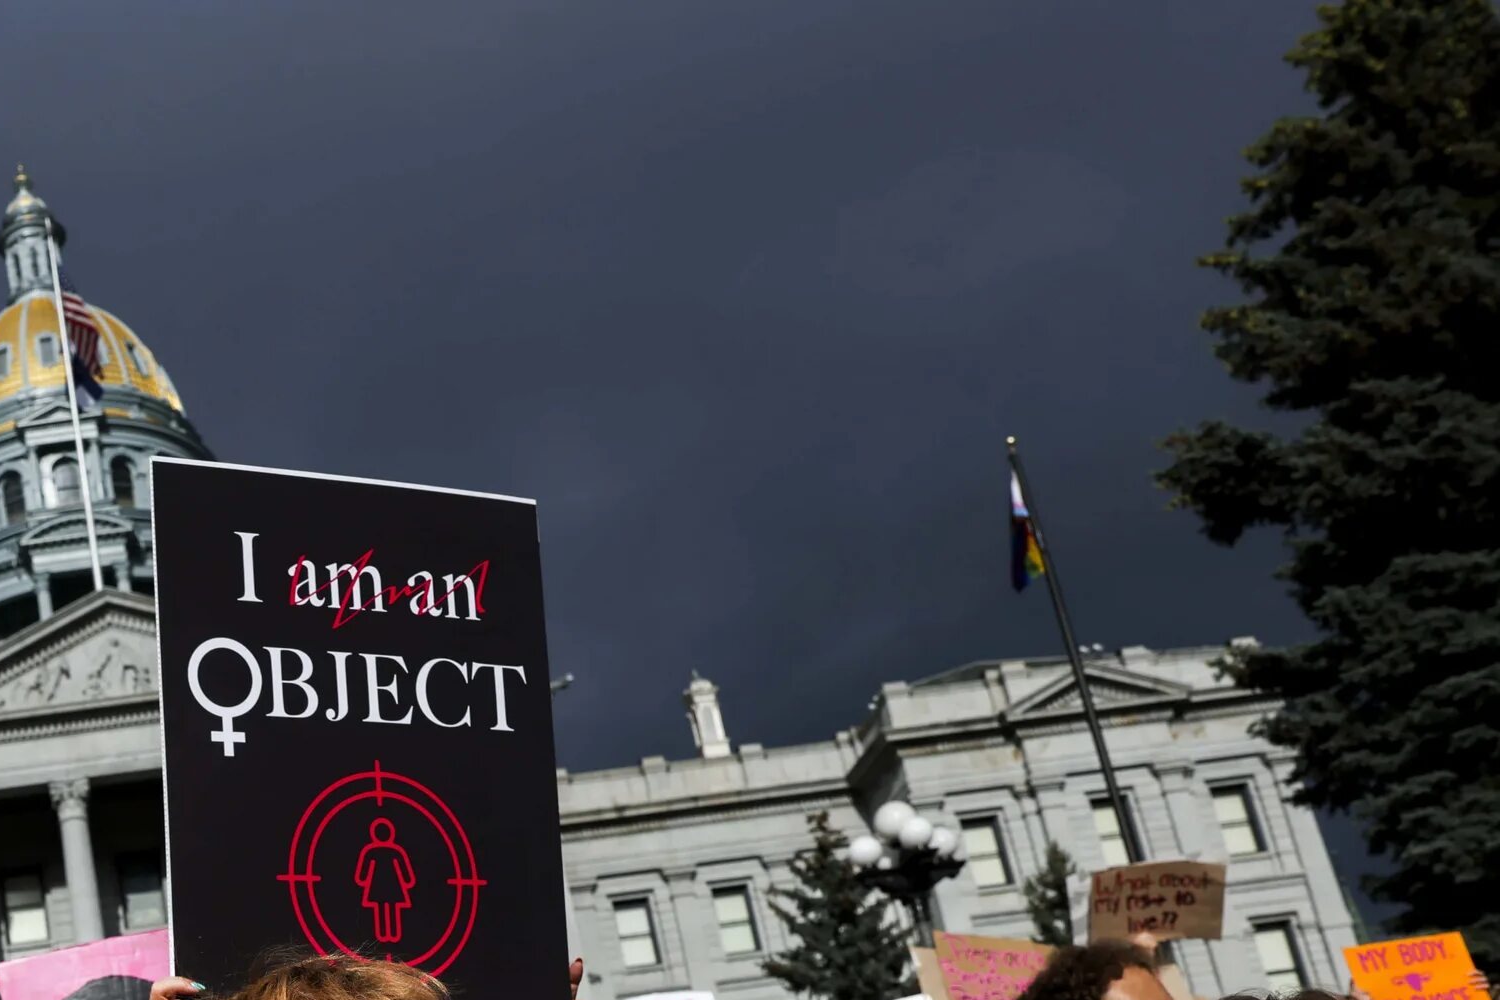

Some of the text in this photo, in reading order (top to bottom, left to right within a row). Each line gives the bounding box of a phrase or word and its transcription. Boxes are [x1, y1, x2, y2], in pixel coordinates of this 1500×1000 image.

[233, 531, 482, 621] I am an
[187, 637, 528, 757] OBJECT
[1356, 946, 1389, 973] MY
